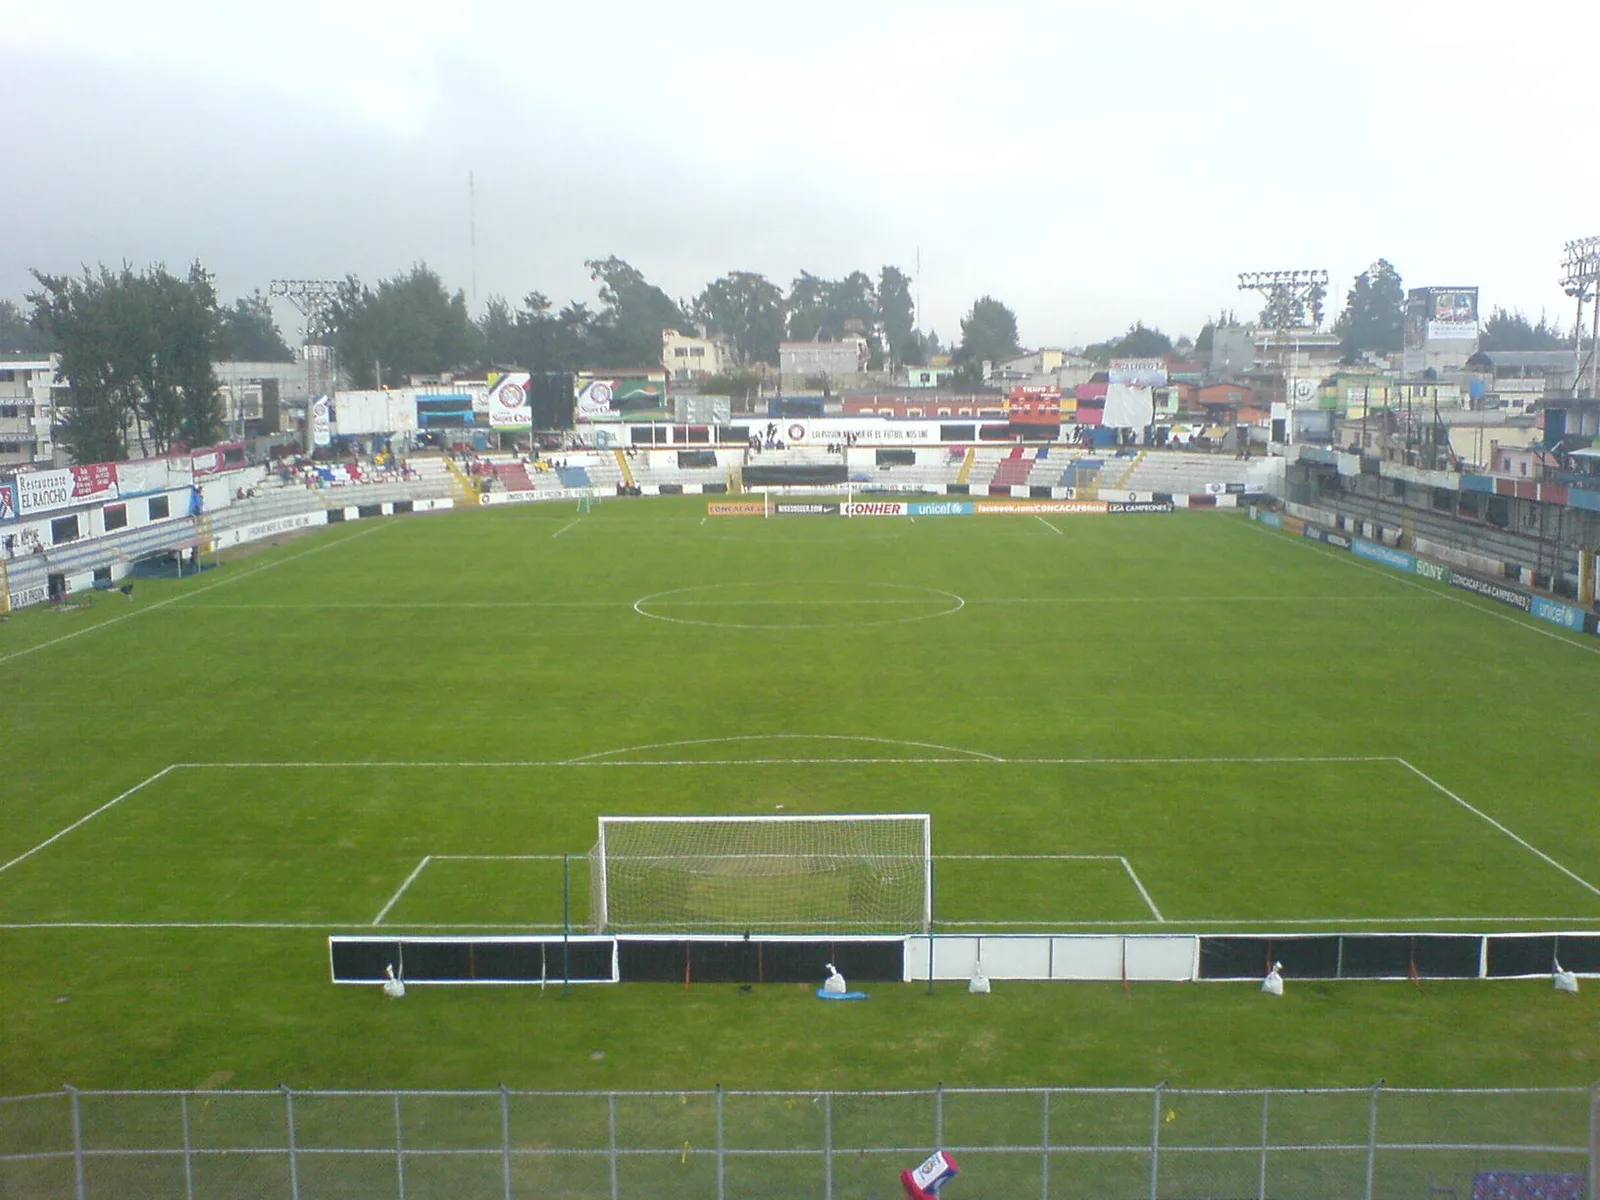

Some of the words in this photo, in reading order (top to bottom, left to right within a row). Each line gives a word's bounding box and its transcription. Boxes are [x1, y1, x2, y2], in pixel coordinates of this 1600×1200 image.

[20, 475, 66, 492] Restaurante
[22, 494, 31, 509] EL
[34, 487, 67, 508] RANCHO
[846, 504, 901, 514] GONHER
[919, 503, 951, 515] unicef
[1416, 559, 1444, 581] SONY
[1540, 602, 1566, 624] unicef
